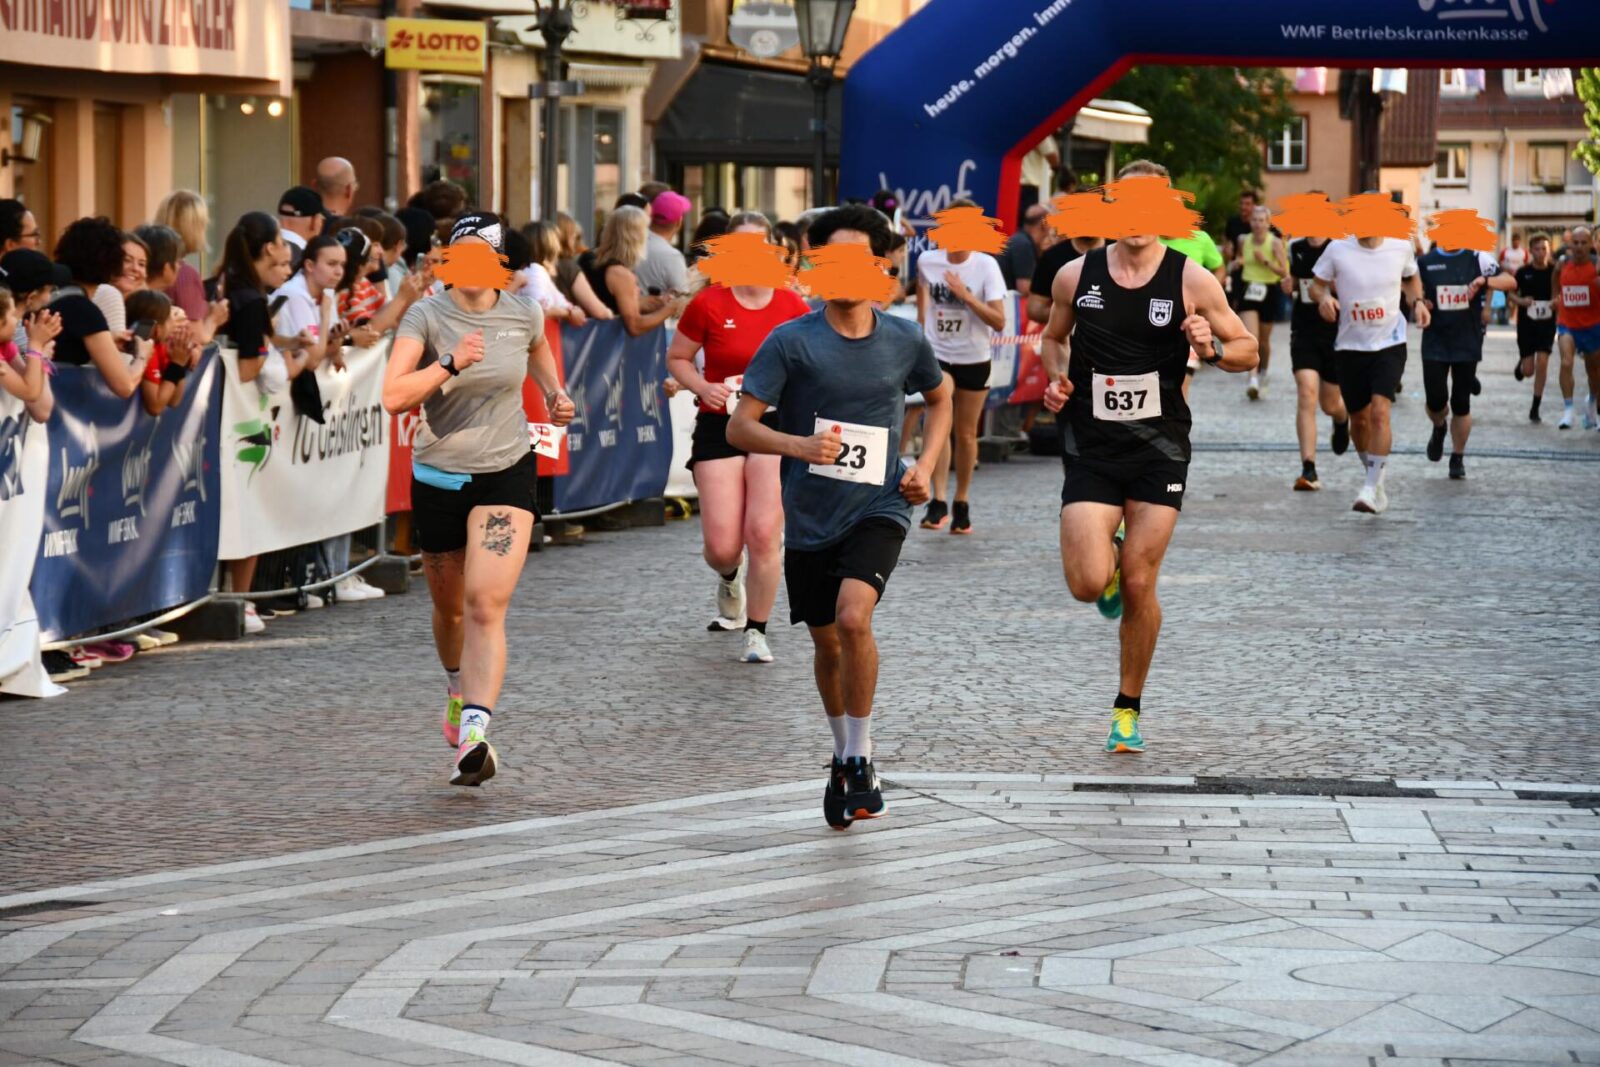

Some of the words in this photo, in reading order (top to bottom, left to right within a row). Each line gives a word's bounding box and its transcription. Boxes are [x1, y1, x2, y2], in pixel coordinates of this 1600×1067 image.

[417, 32, 481, 52] LOTTO
[1280, 24, 1326, 39] WMF
[1331, 25, 1529, 42] Betriebskrankenkasse
[923, 79, 975, 118] heute.
[974, 26, 1038, 79] morgen.
[1439, 294, 1467, 305] 1144
[1351, 307, 1385, 322] 1169
[937, 319, 962, 333] 527
[1104, 389, 1148, 412] 637
[834, 442, 867, 470] 23
